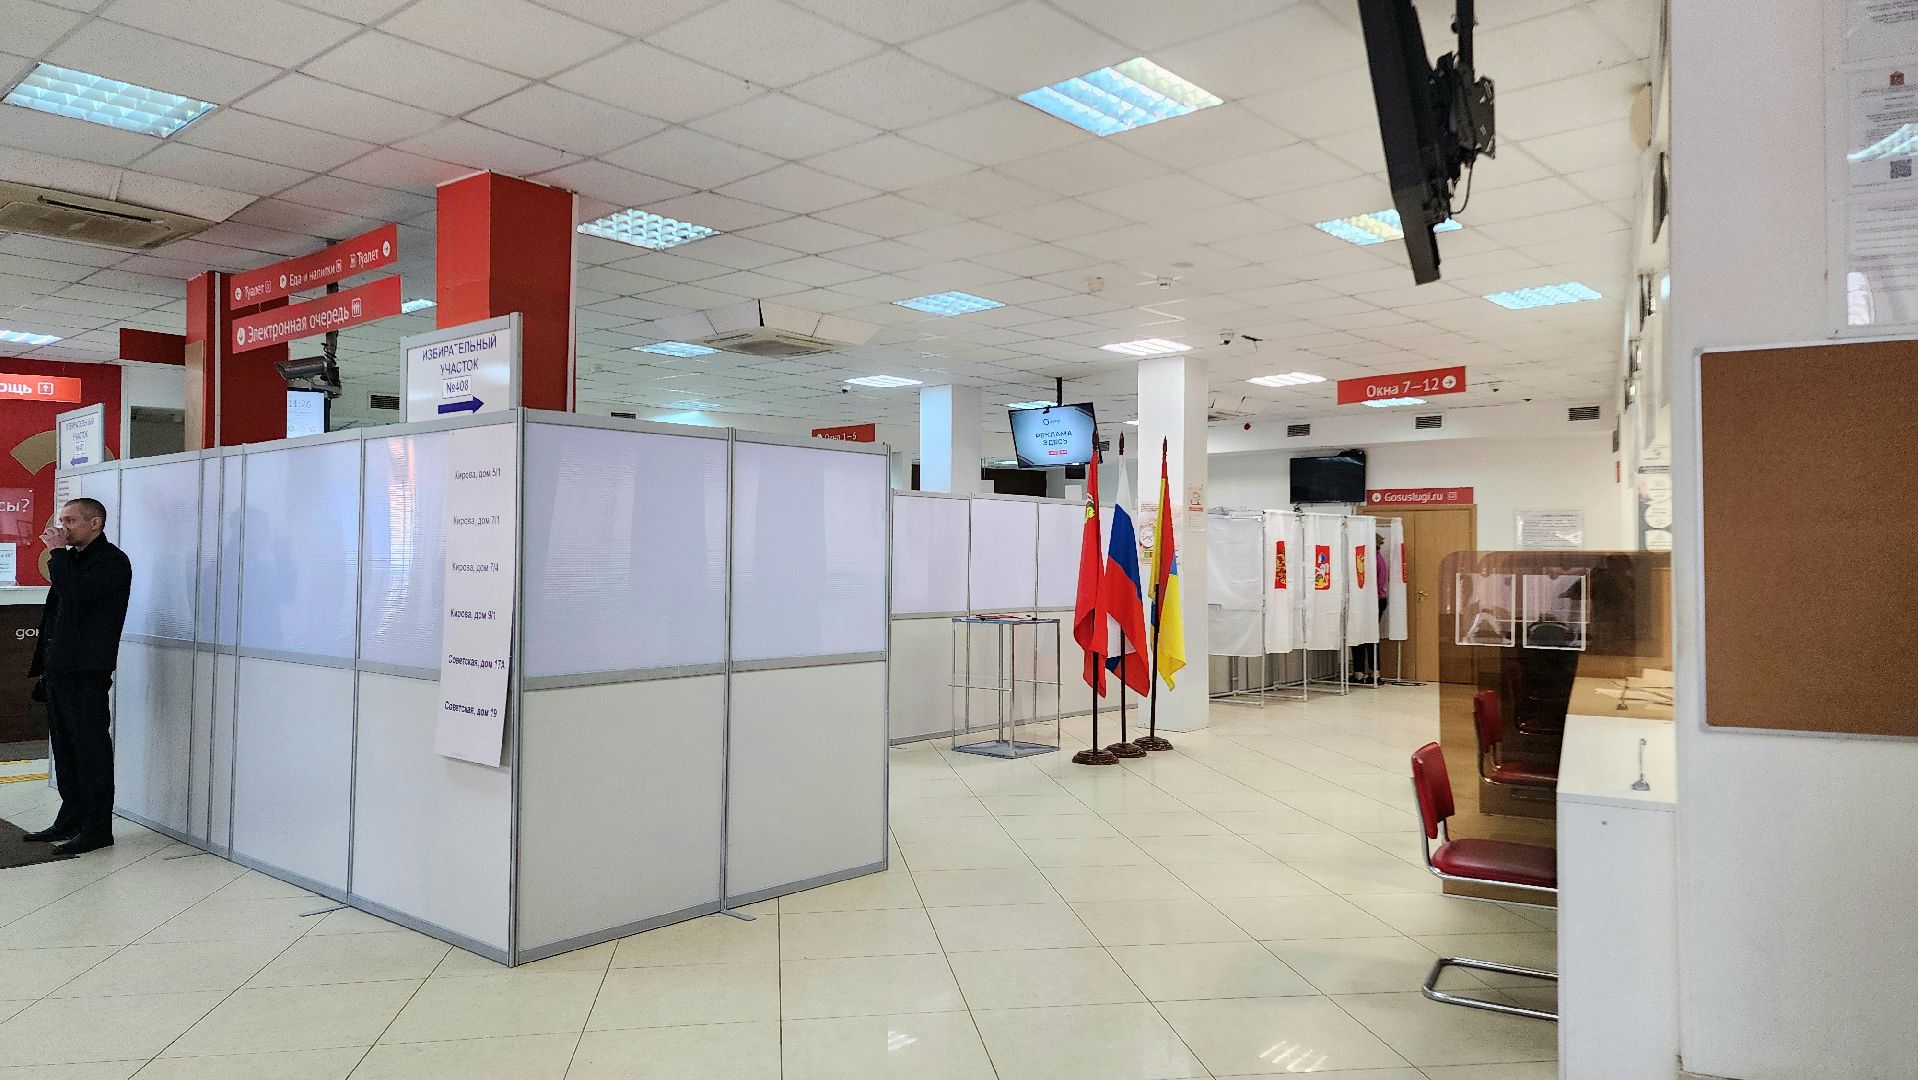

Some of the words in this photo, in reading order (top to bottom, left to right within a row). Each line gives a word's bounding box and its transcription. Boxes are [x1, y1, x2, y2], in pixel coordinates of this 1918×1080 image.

[357, 248, 379, 268] Туалет
[289, 272, 302, 287] Еда
[309, 264, 336, 283] напитки
[244, 285, 265, 301] Туалет
[247, 317, 307, 344] Электронная
[309, 305, 349, 329] очередь
[422, 333, 497, 361] ИЗБИРАТЕЛЬНЫЙ
[440, 358, 479, 376] УЧАСТОК
[446, 380, 469, 394] №408
[1366, 384, 1399, 398] Окна
[1035, 430, 1072, 438] РЕКЛАМА
[455, 470, 478, 481] Кирова,
[479, 469, 491, 478] дом
[1384, 492, 1444, 504] Gosuslugi.ru
[453, 515, 477, 527] Кирова,
[477, 516, 490, 527] дом
[491, 515, 500, 525] 7/1
[452, 562, 475, 573] Кирова,
[476, 563, 489, 573] дом
[490, 562, 499, 572] 7/4
[450, 608, 473, 621] Кирова,
[473, 611, 487, 621] дом
[487, 610, 496, 621] 9/1
[448, 654, 480, 669] Советская,
[480, 658, 493, 669] дом
[444, 700, 476, 716] Советская,
[476, 706, 489, 717] дом
[490, 707, 498, 718] 19
